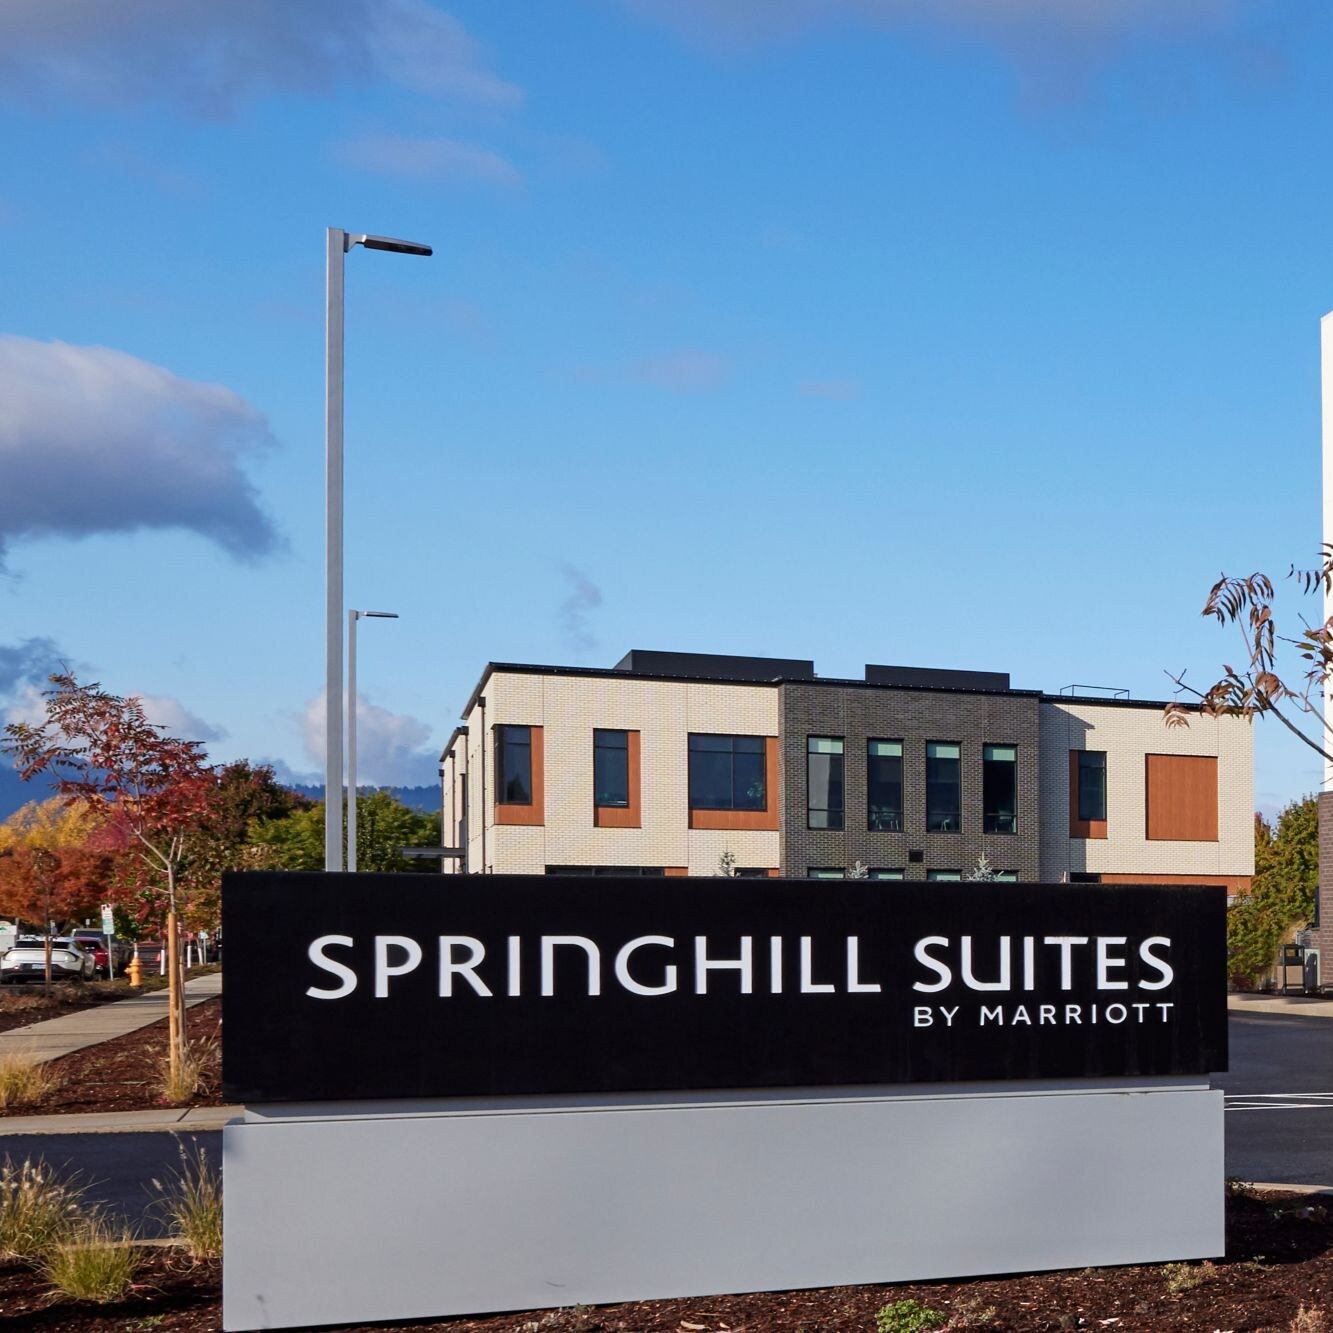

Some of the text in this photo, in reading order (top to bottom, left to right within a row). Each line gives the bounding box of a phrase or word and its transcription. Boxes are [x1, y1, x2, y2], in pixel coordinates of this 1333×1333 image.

[306, 934, 1174, 999] SPRINGHILL SUITES
[914, 1003, 1174, 1028] BY MARRIOTT
